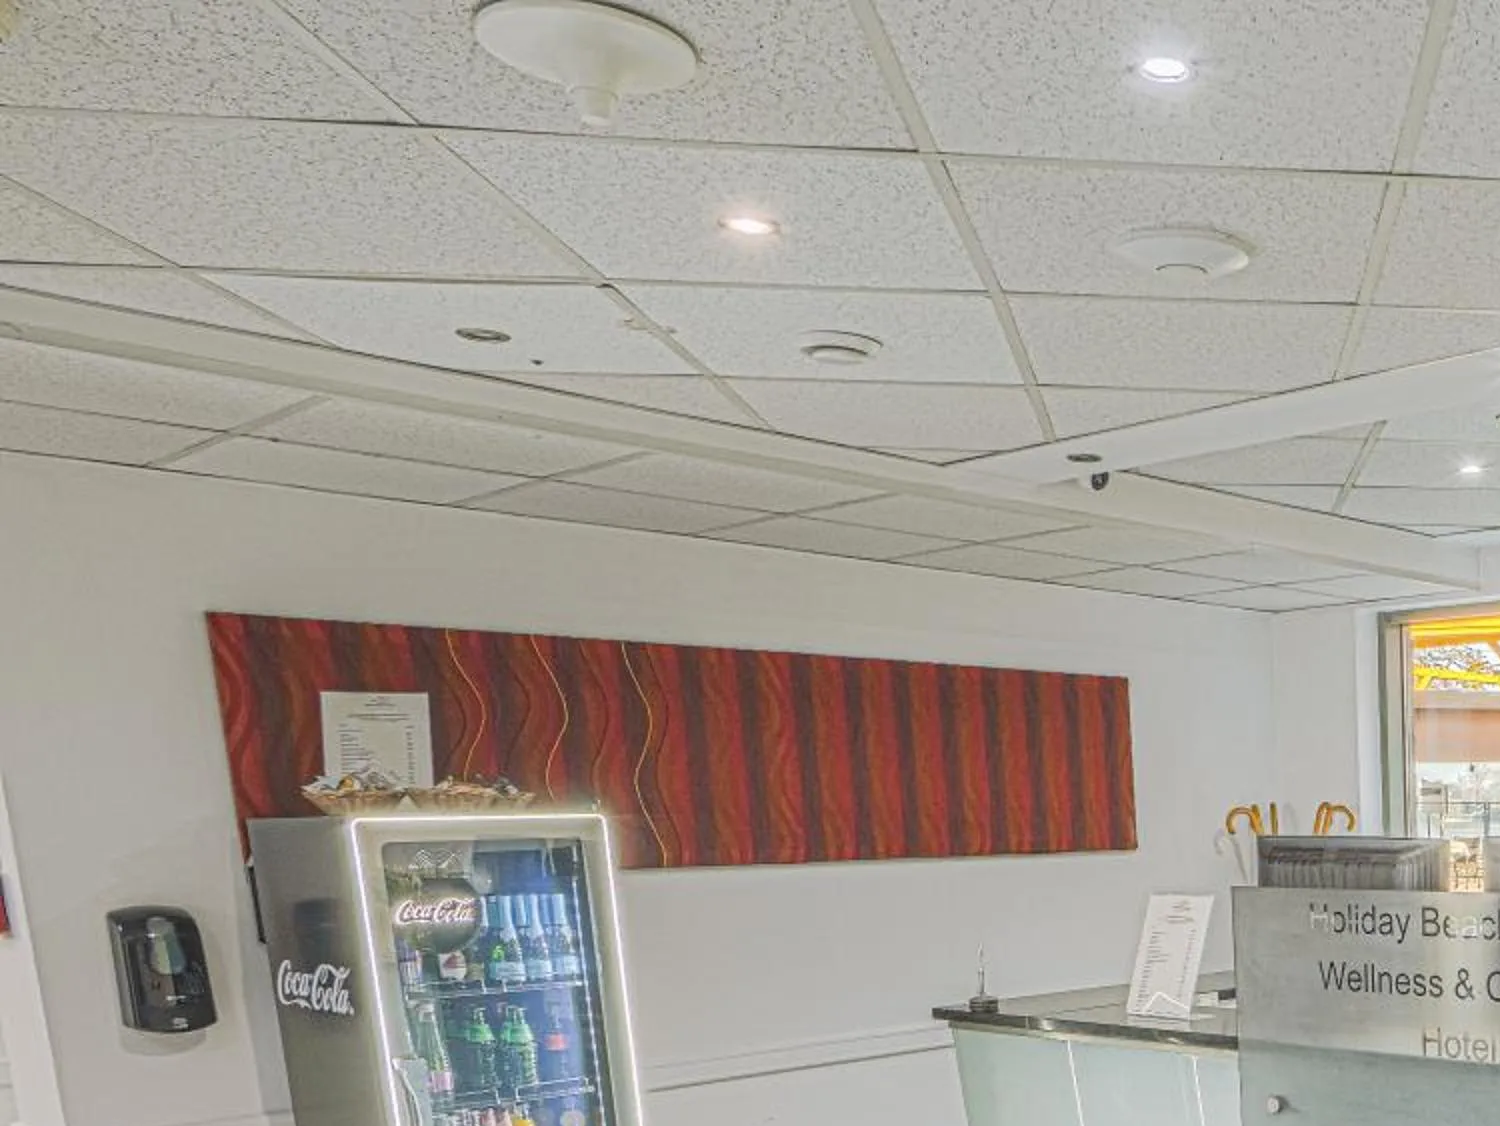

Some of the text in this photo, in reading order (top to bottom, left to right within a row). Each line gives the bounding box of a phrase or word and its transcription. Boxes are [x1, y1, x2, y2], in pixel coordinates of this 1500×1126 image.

[1309, 902, 1411, 944] Holiday
[1318, 960, 1444, 998] Wellness
[1455, 967, 1475, 1001] &
[1422, 1025, 1497, 1063] Hotel
